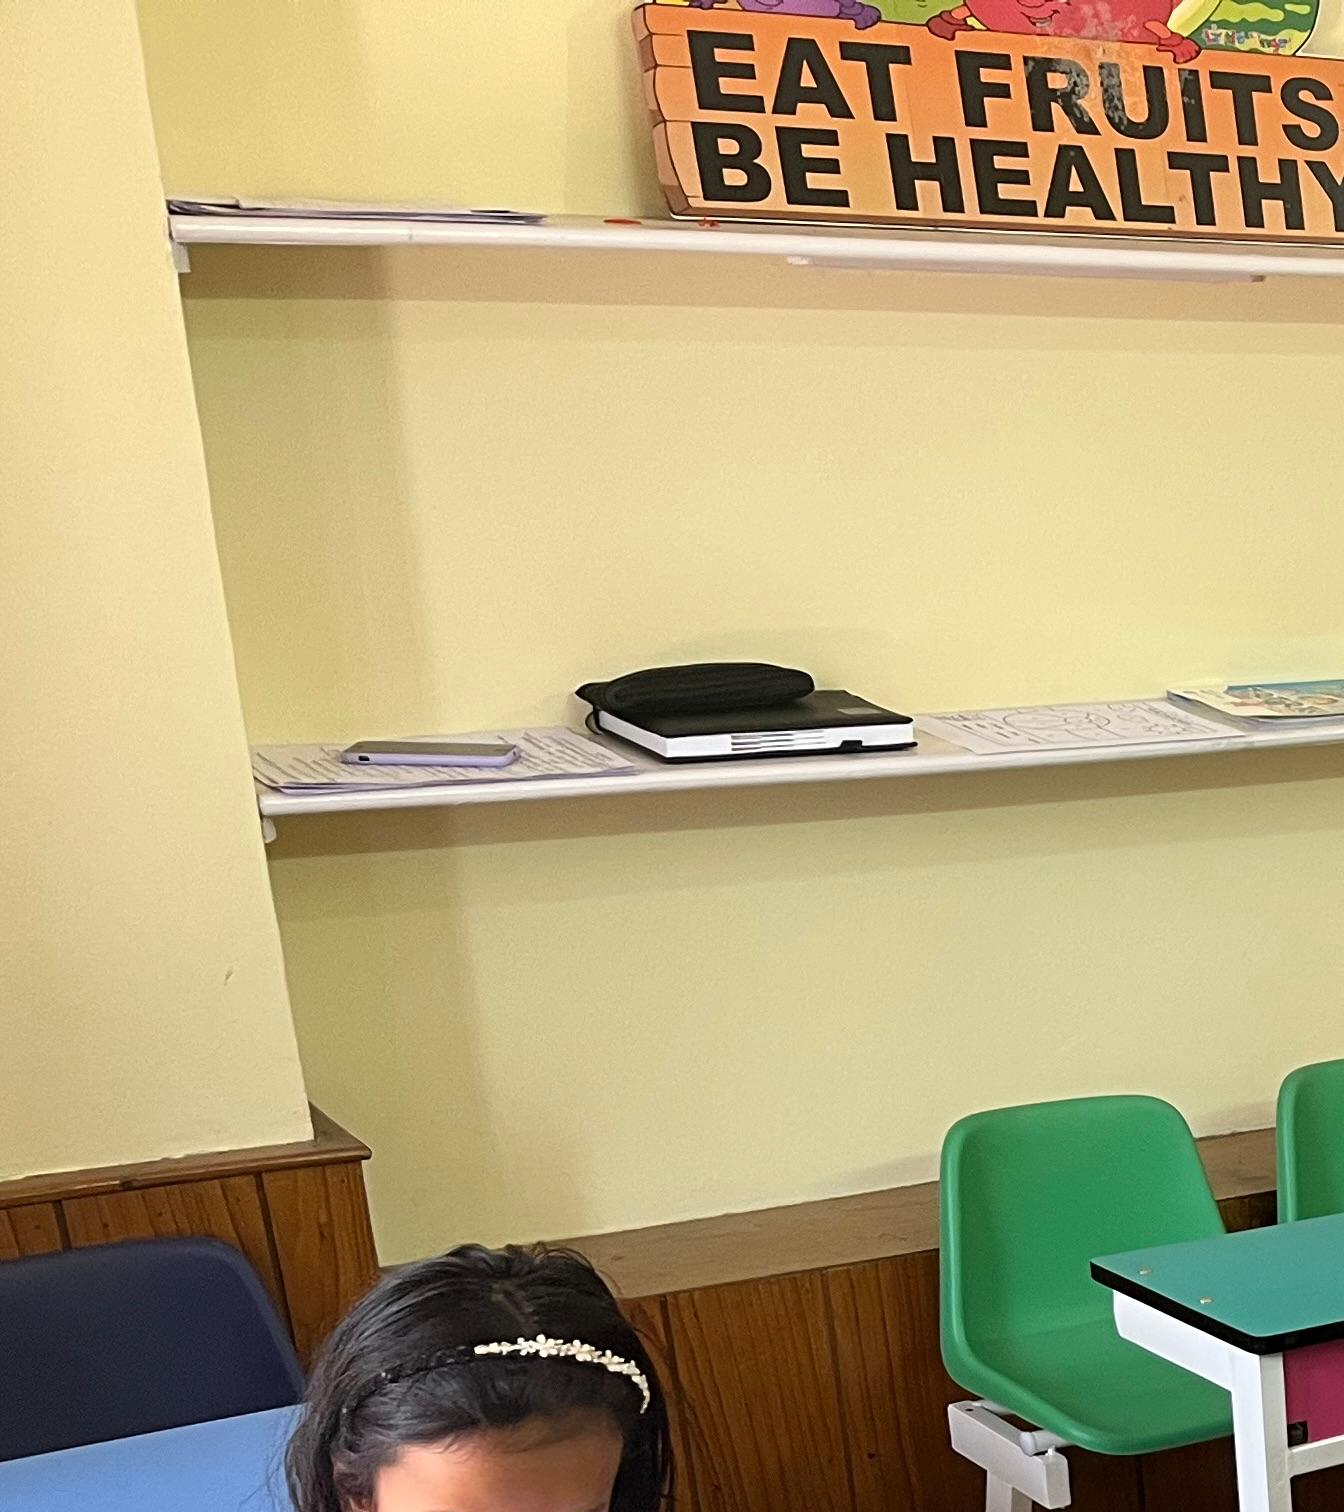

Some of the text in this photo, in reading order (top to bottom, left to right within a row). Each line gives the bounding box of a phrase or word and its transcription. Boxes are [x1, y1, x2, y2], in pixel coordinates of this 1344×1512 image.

[685, 28, 1340, 152] EAT FRUITS
[690, 121, 851, 209] BE
